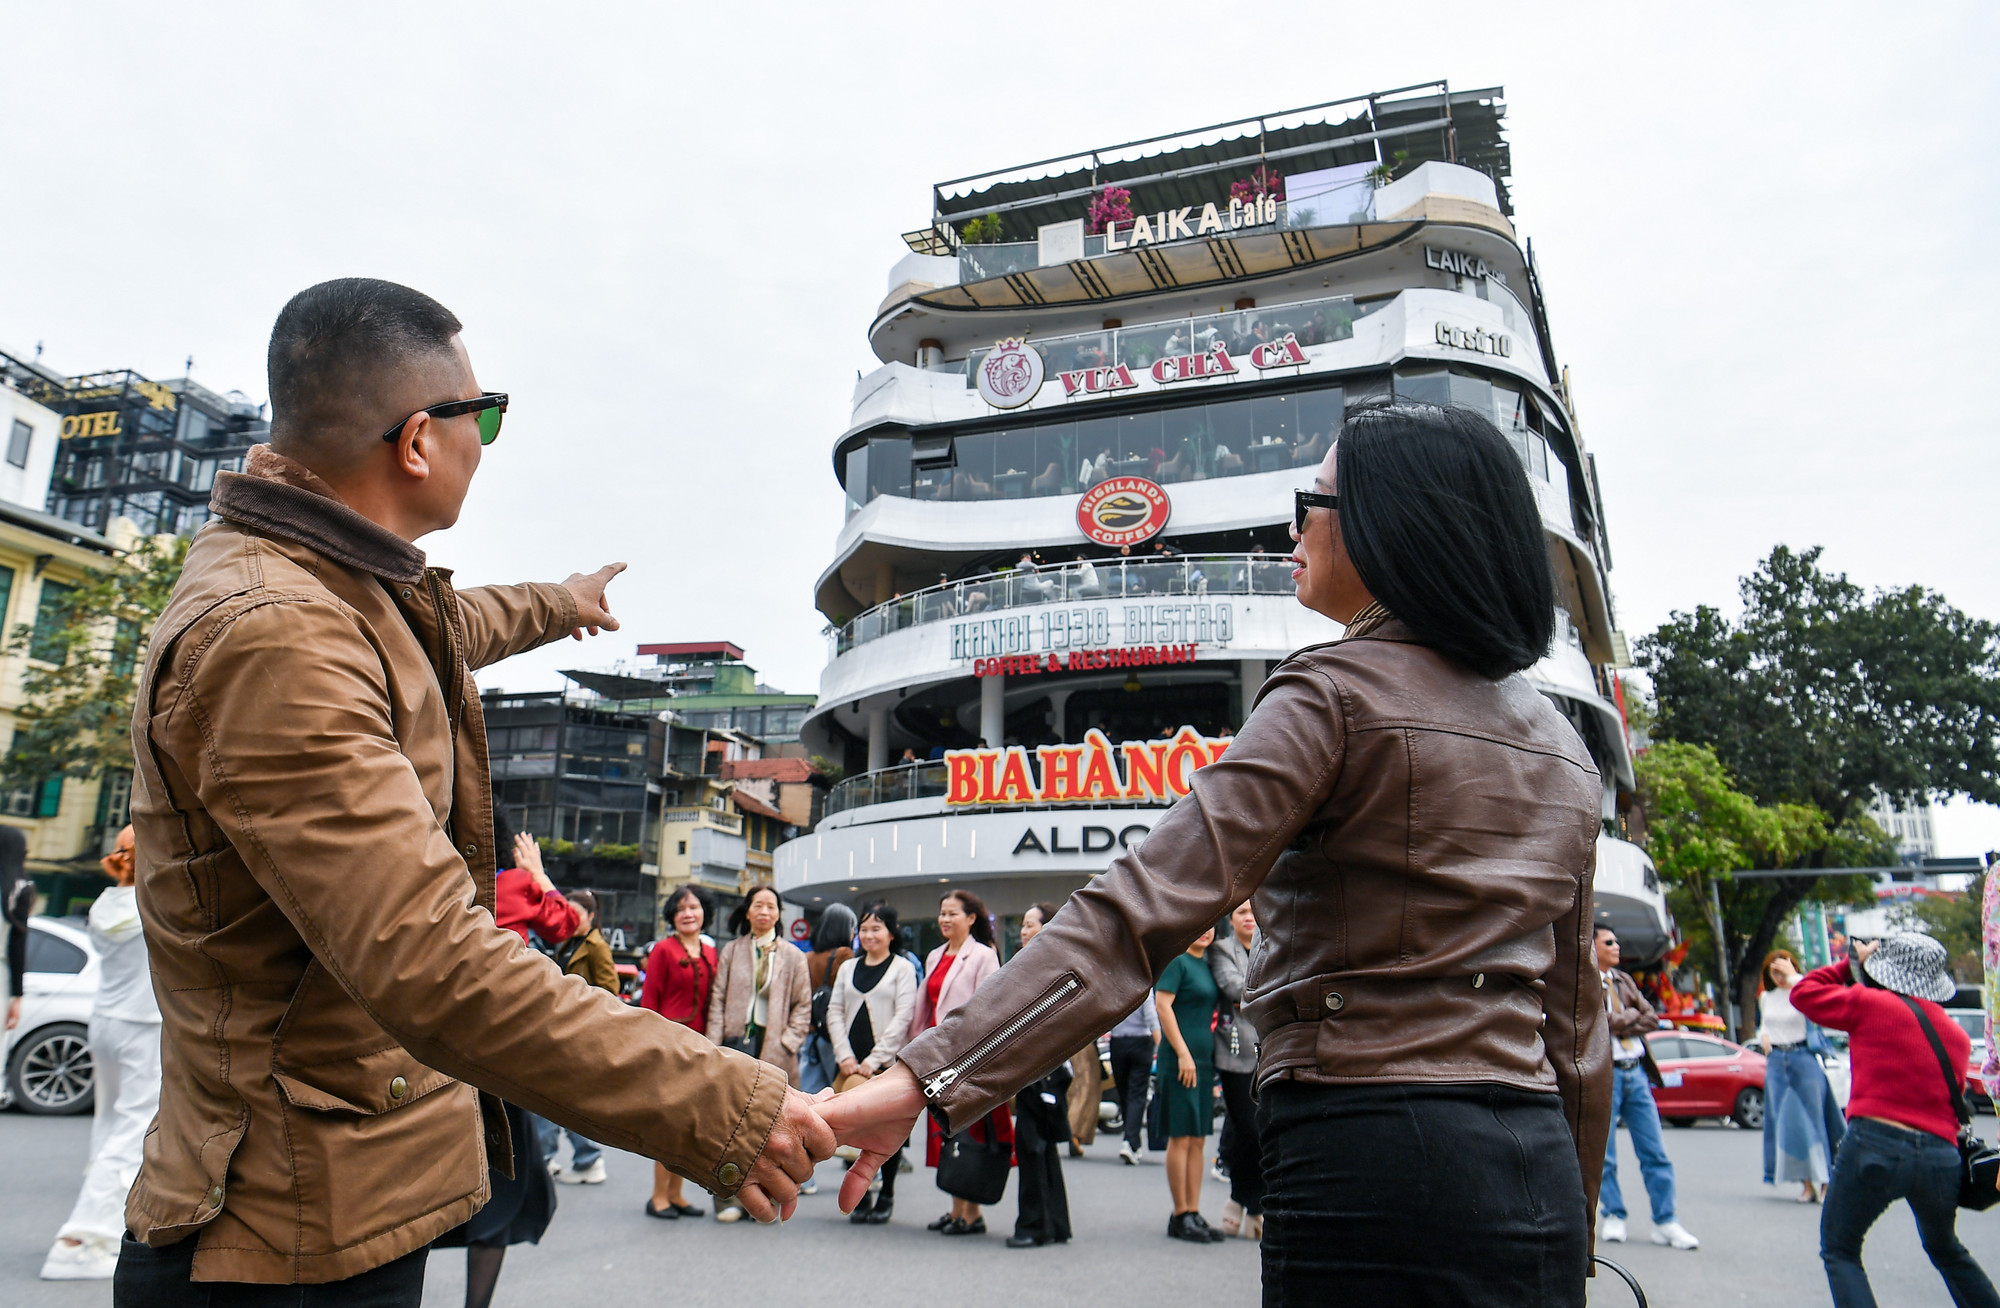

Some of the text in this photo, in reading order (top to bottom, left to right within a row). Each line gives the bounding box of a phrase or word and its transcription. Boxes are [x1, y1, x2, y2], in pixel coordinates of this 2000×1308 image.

[1107, 192, 1278, 252] LAIKA Café
[1425, 245, 1489, 280] LAIKA
[1489, 332, 1513, 358] 10
[1057, 332, 1311, 397] VUA CHẢ CÁ
[1081, 480, 1165, 513] HIGHLANDS
[1092, 522, 1156, 543] COFFEE
[950, 603, 1234, 660] HANOI 1930 BISTRO
[974, 642, 1200, 678] COFFEE & RESTAURANT
[946, 749, 1036, 806] BIA
[1039, 730, 1122, 803] HÀ
